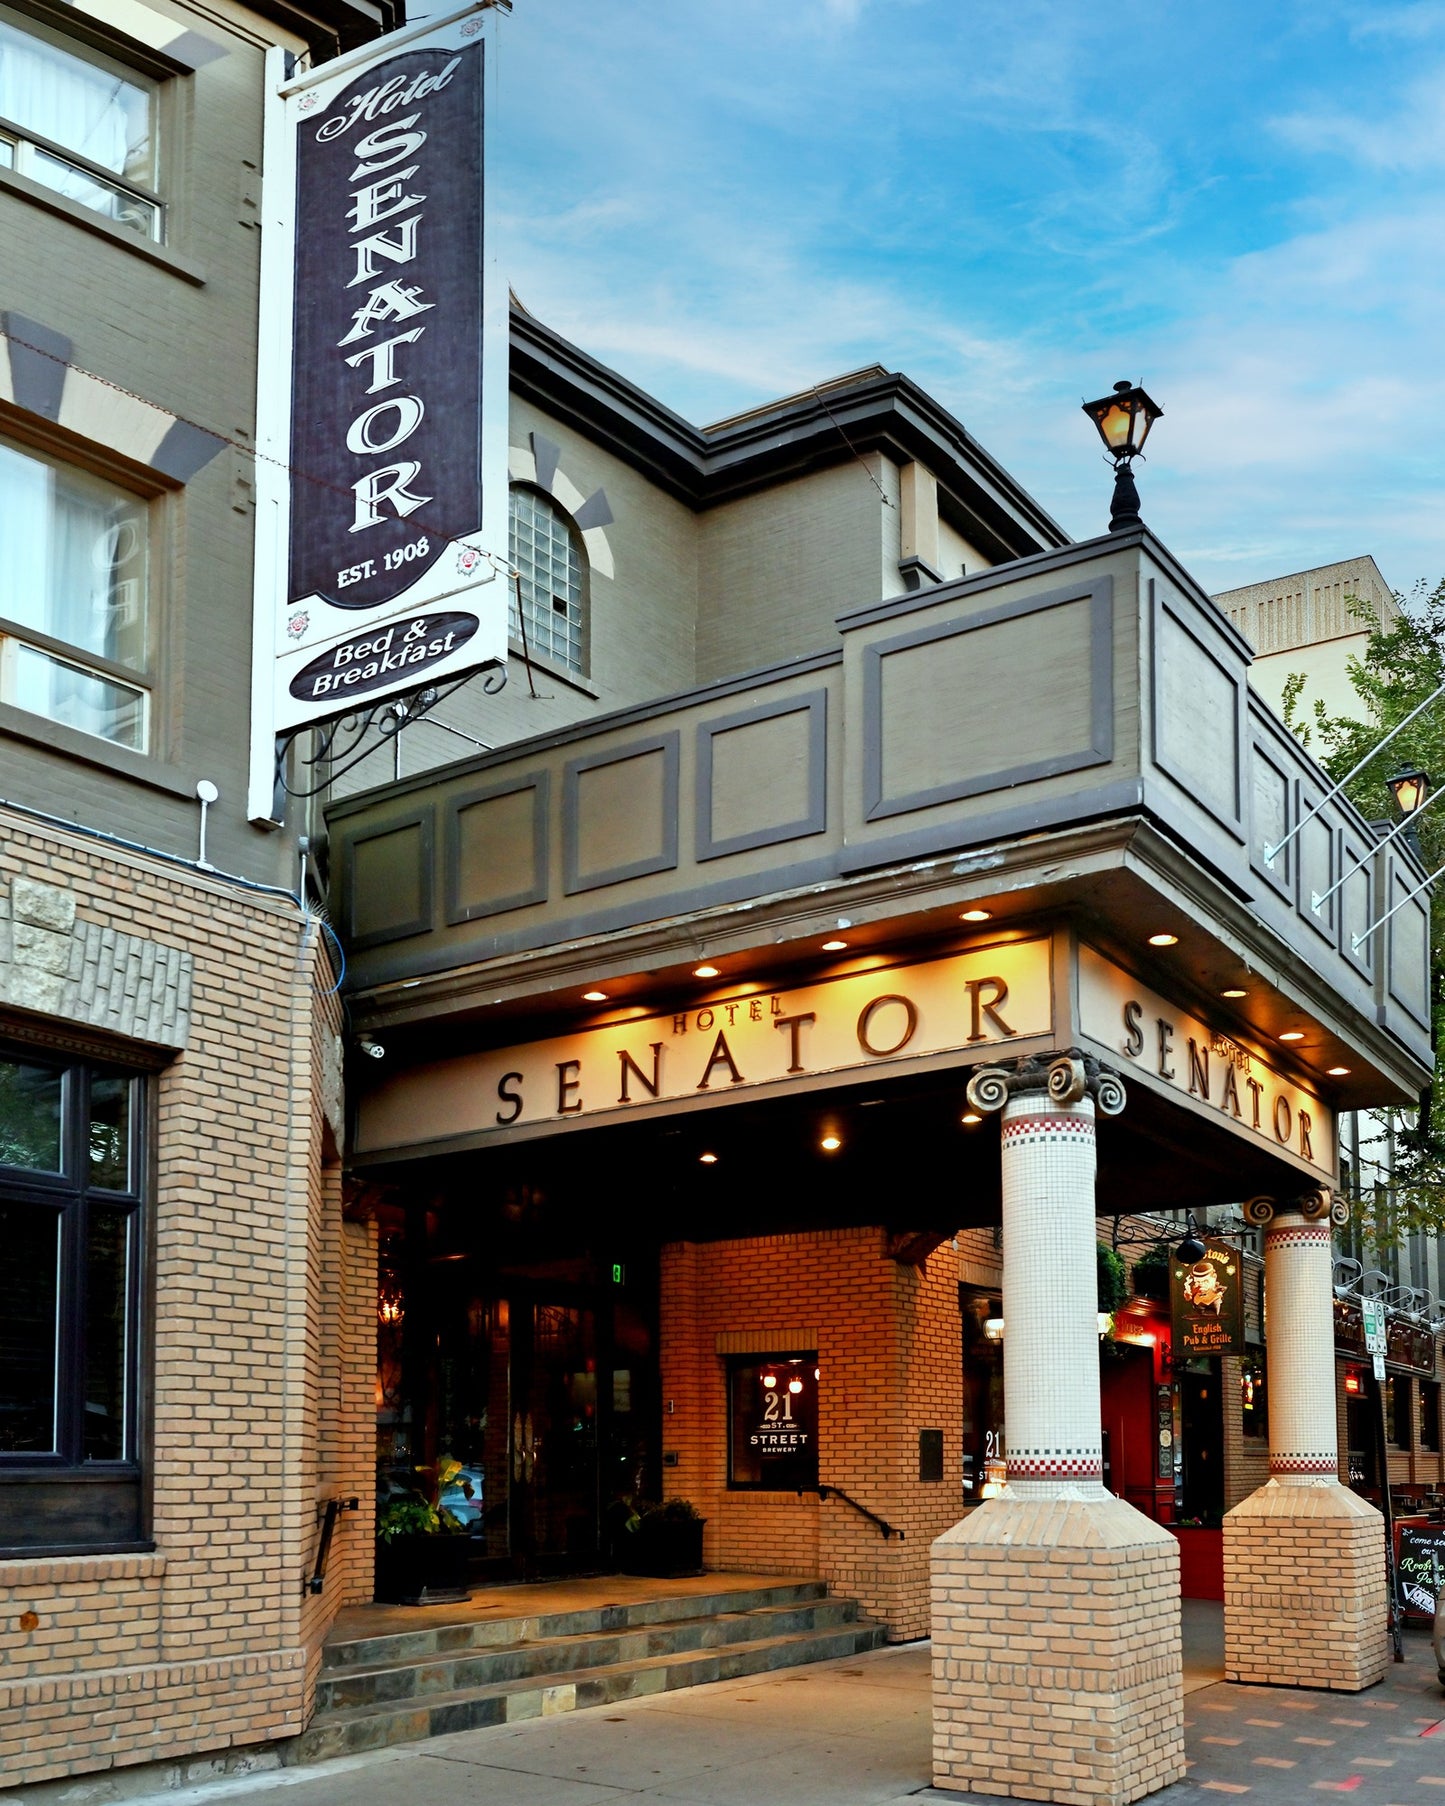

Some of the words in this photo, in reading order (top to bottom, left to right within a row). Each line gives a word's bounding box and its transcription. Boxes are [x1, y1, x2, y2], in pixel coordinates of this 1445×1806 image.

[315, 57, 462, 143] Hotel
[337, 112, 436, 533] SENATOR
[337, 560, 377, 588] EST.
[384, 537, 429, 571] 1908
[333, 628, 394, 668] Bed
[403, 619, 428, 643] &
[312, 631, 455, 696] Breakfast
[672, 995, 784, 1034] HOTEL
[496, 975, 1017, 1124] SENATOR
[1122, 1000, 1314, 1161] SENATOR
[1183, 1335, 1200, 1346] Pub
[1201, 1335, 1208, 1345] &
[1192, 1323, 1222, 1336] English
[764, 1391, 793, 1421] 21
[750, 1434, 808, 1445] STREET
[985, 1430, 1000, 1458] 21
[1409, 1537, 1431, 1545] come
[1400, 1557, 1445, 1573] Roofo
